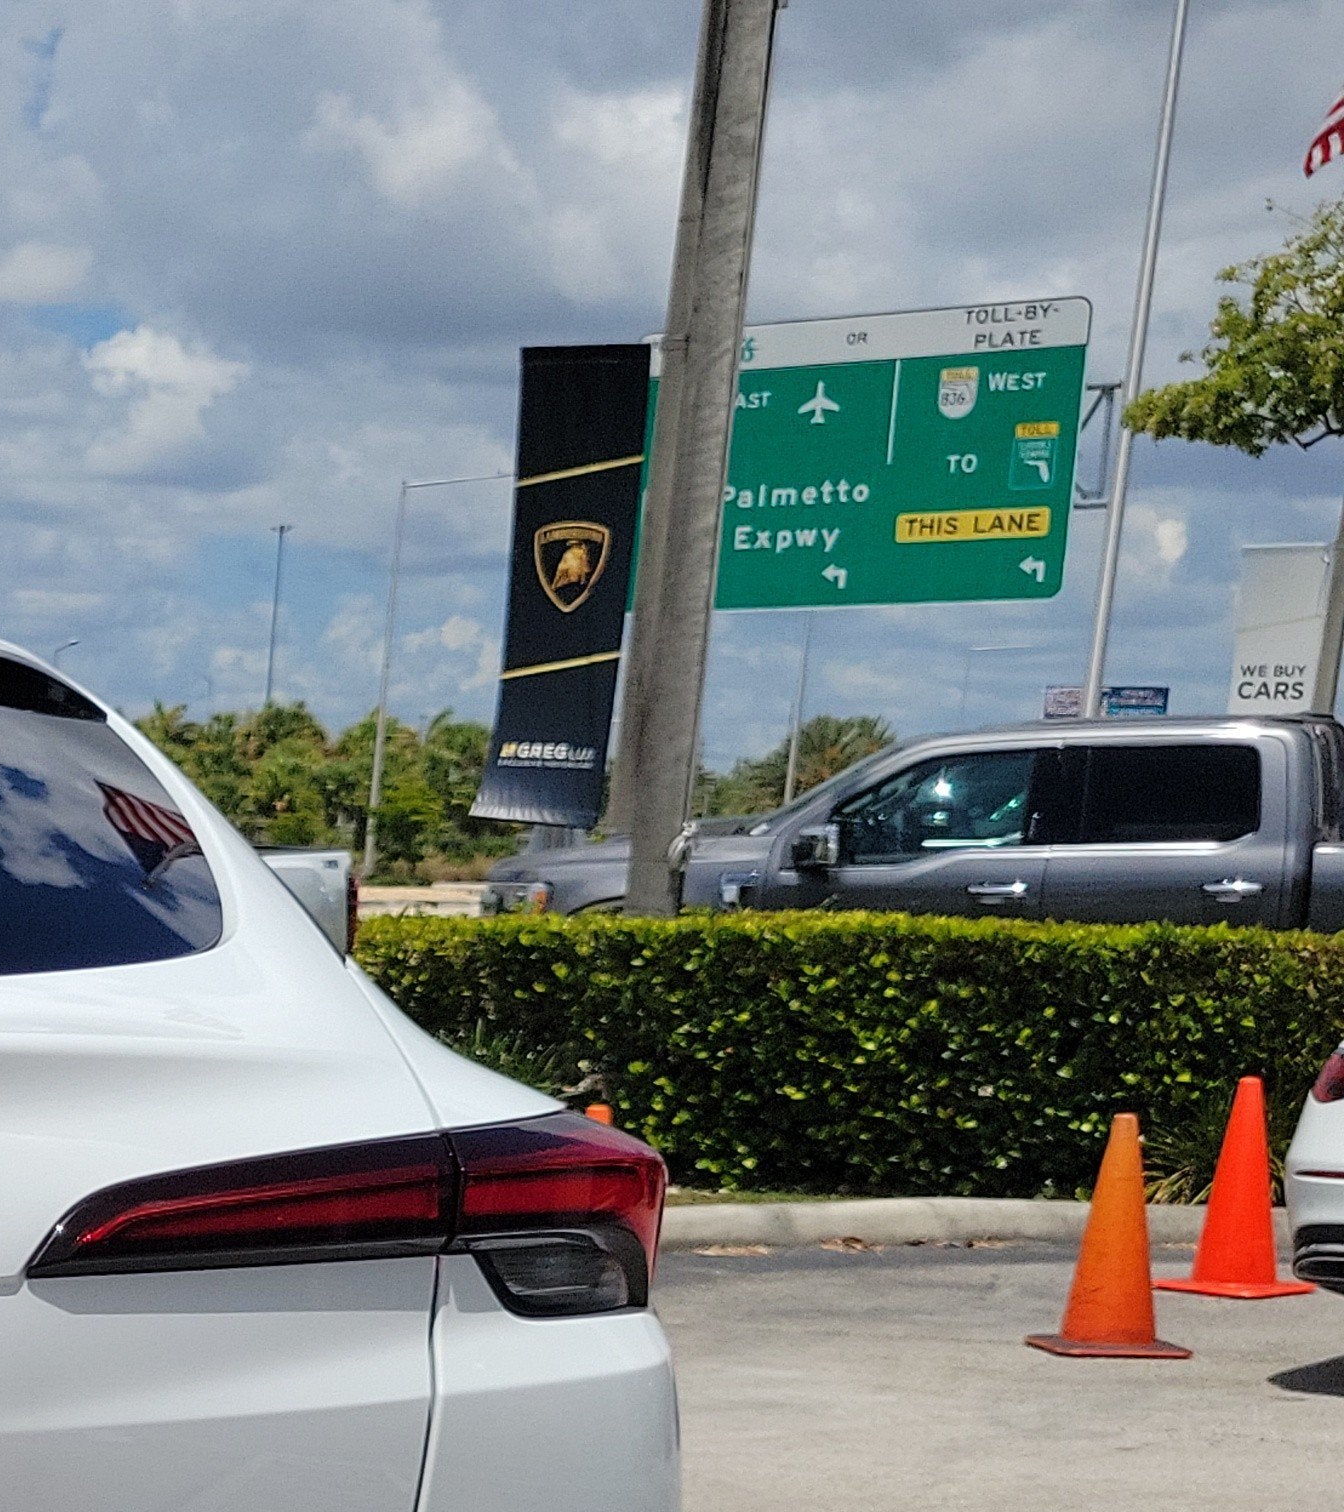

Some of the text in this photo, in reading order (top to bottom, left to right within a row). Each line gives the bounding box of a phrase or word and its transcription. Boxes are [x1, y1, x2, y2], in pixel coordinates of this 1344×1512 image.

[846, 332, 869, 346] OR
[974, 329, 1043, 348] PLATE
[988, 371, 1047, 391] WEST
[733, 390, 772, 409] AST
[947, 453, 978, 474] TO
[722, 479, 870, 509] Palmetto
[905, 512, 1042, 537] THIS LANE
[733, 524, 841, 554] Expwy
[1240, 664, 1307, 678] WE BUY
[1237, 681, 1305, 700] CARS
